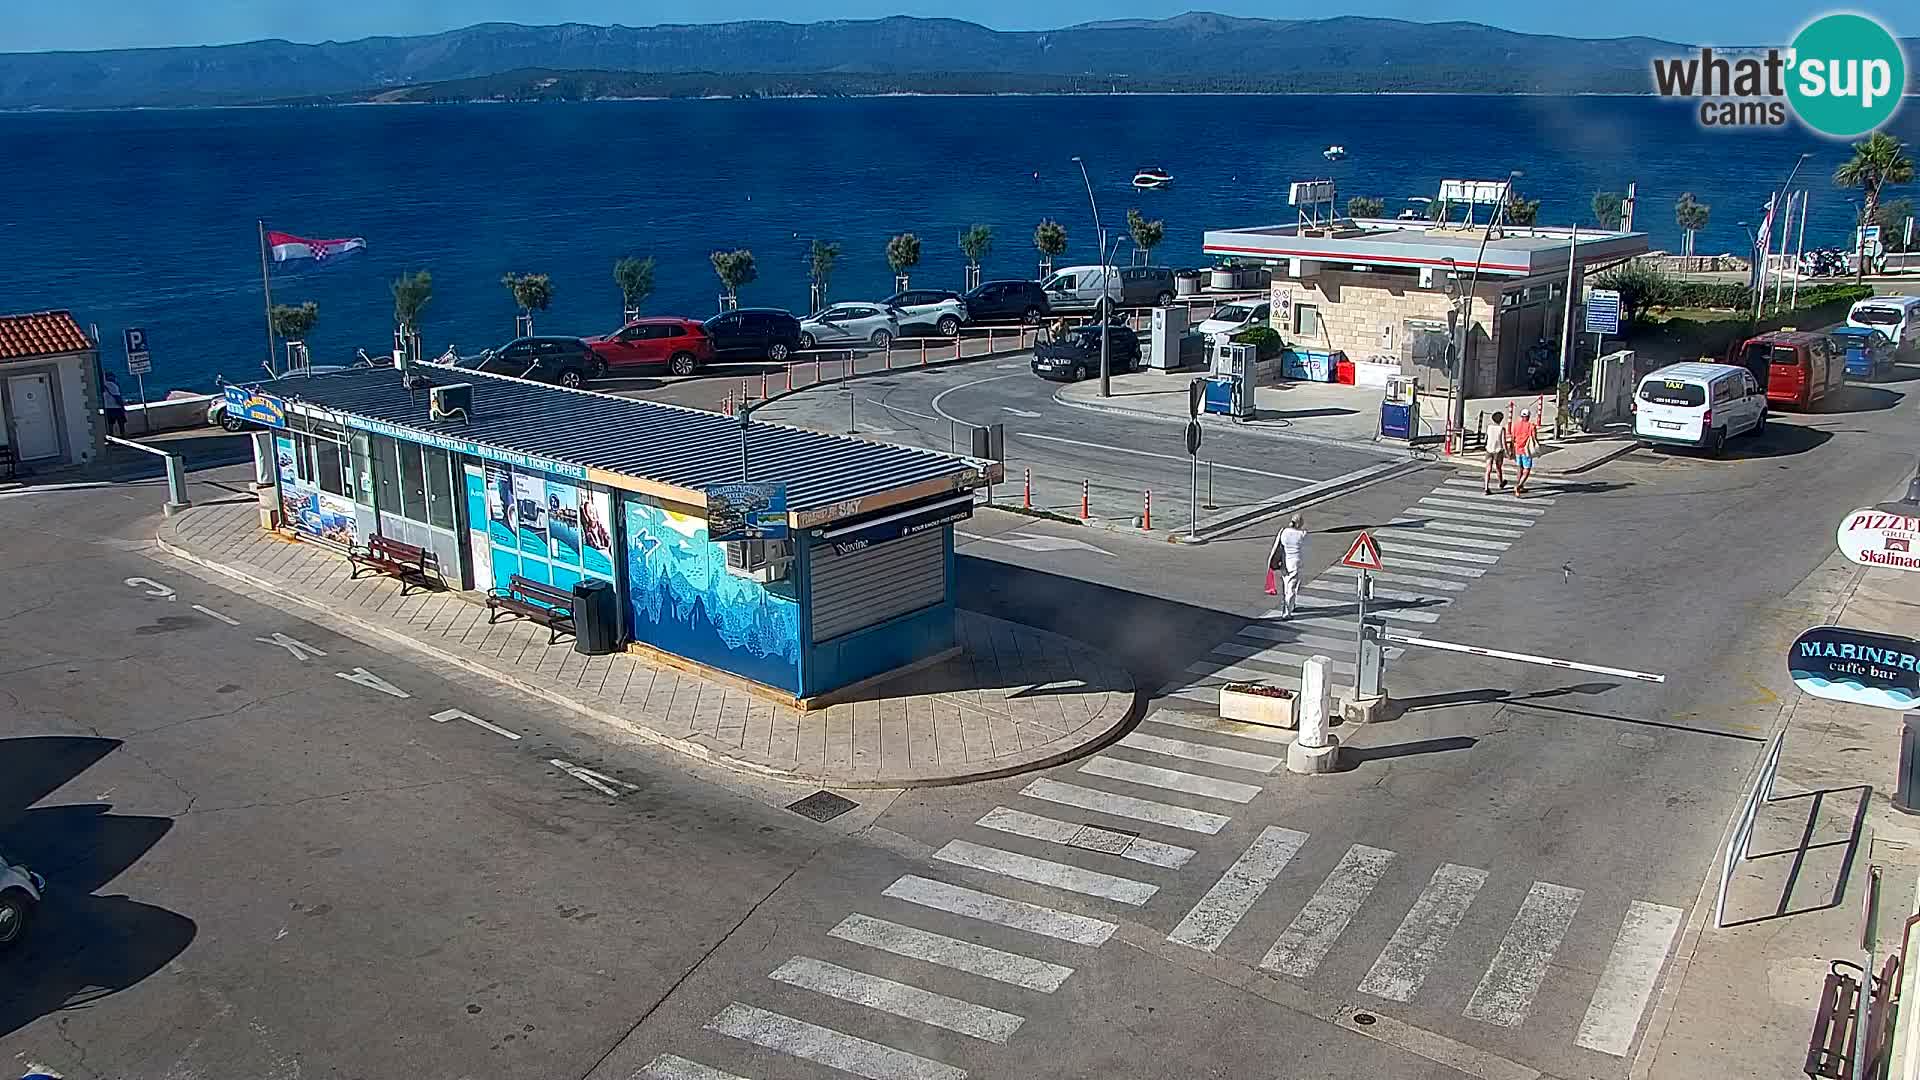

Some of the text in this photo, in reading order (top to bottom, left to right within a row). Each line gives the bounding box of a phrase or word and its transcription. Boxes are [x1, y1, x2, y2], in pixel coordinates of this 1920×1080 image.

[1665, 381, 1684, 390] TAXI
[395, 426, 435, 445] AUTOBUSNA
[436, 435, 467, 452] POSTAJA
[478, 446, 493, 459] BUS
[494, 450, 526, 466] STATION
[528, 457, 553, 472] TICKET
[555, 463, 582, 478] OFFICE
[1849, 515, 1920, 532] PIZZE
[1882, 530, 1916, 541] GRILL
[836, 539, 868, 555] Novine
[1829, 662, 1897, 680] caffe bar
